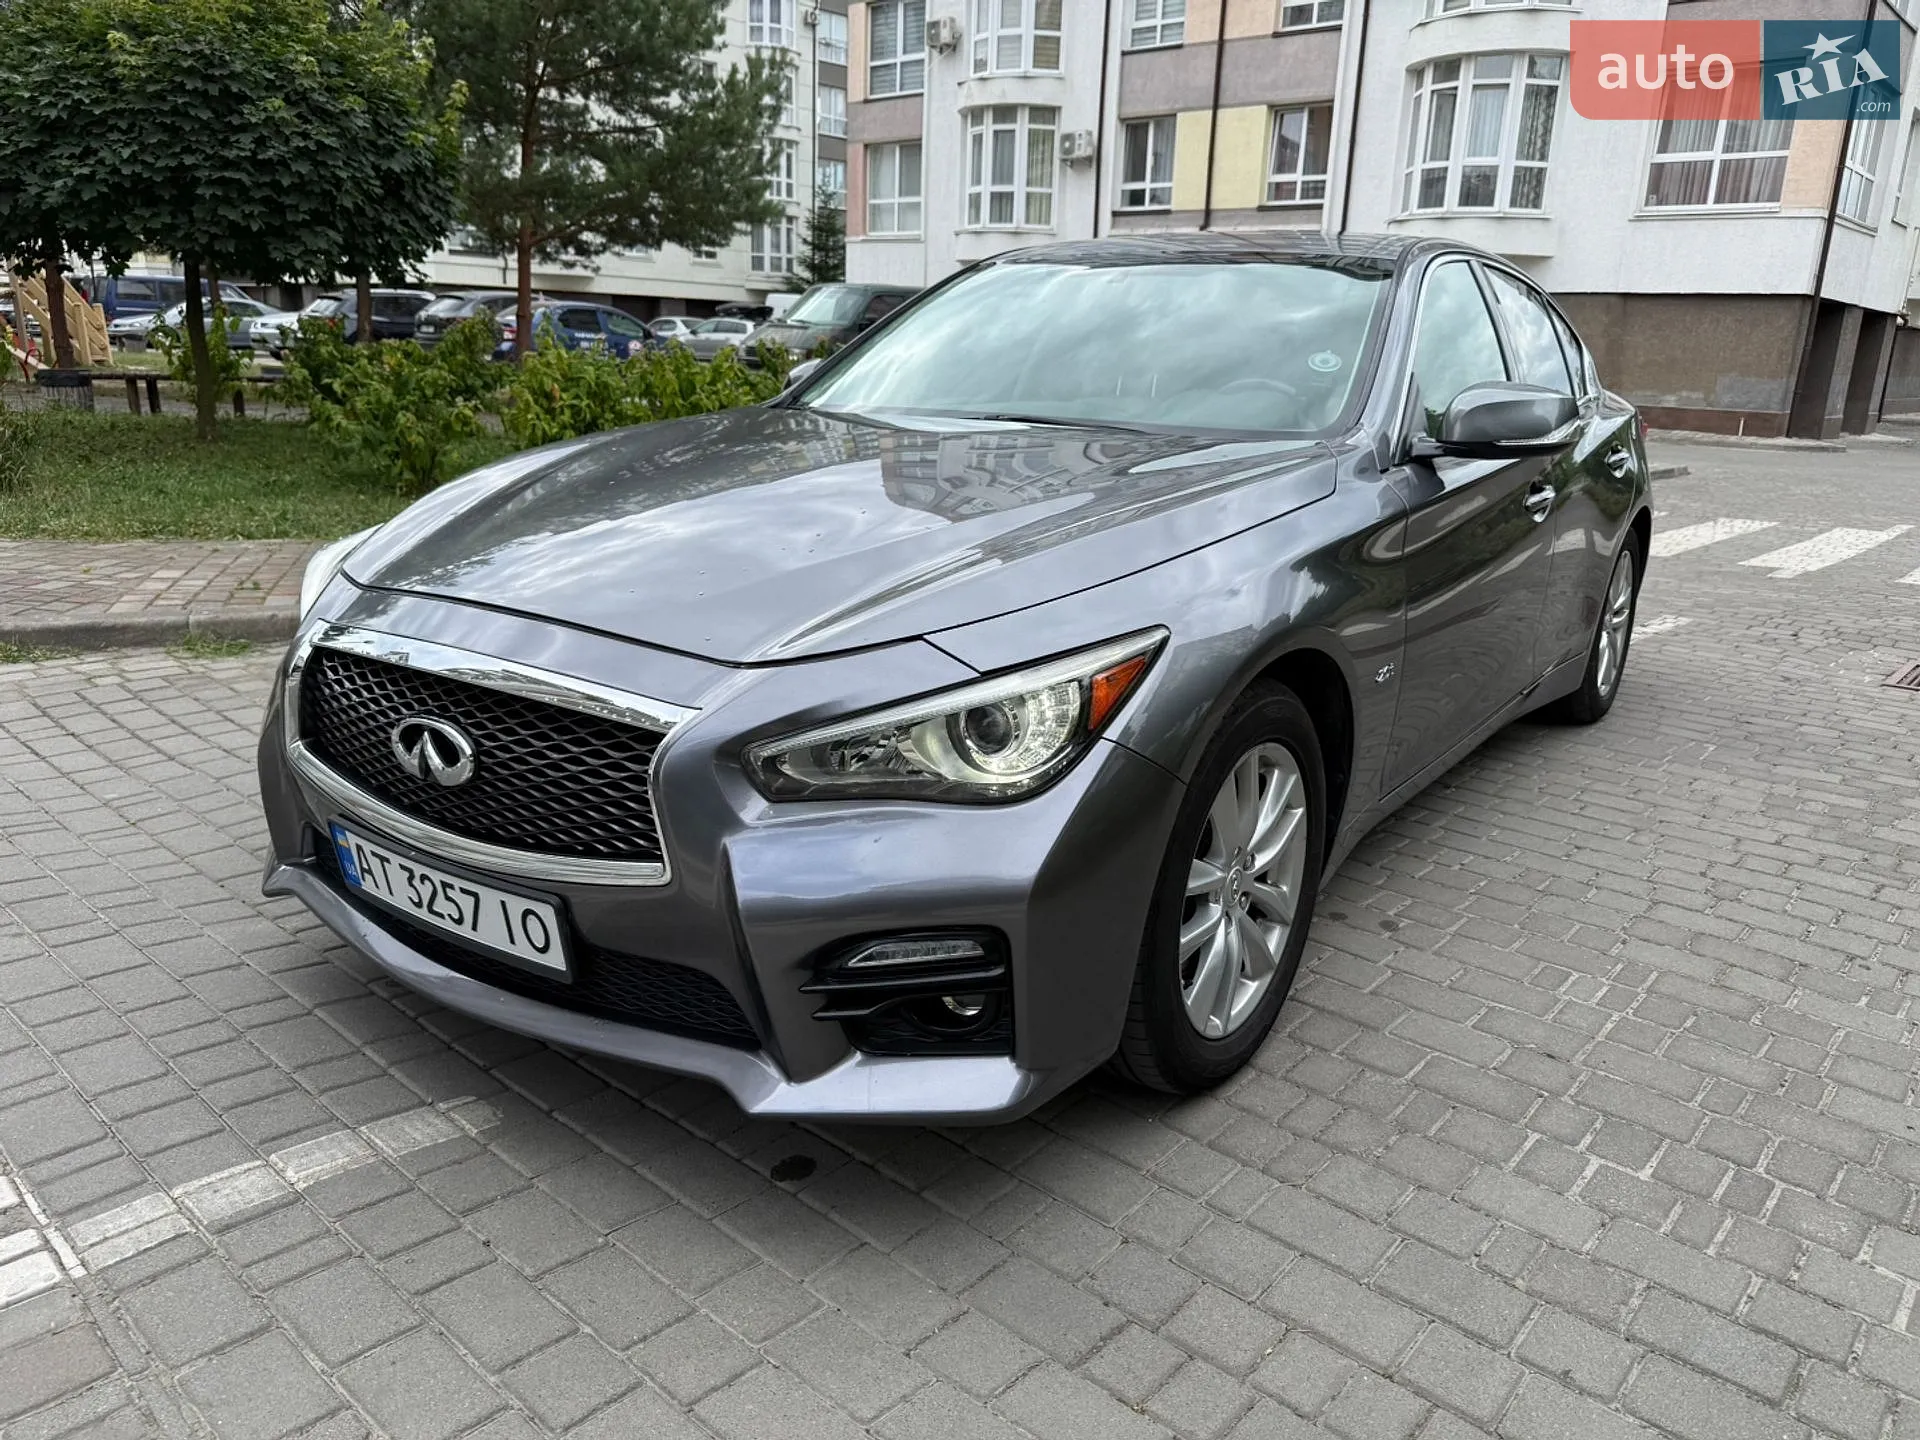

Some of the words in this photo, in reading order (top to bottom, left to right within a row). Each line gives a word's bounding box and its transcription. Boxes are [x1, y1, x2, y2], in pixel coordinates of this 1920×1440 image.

[355, 842, 394, 897] AT
[399, 862, 481, 932] 3257
[500, 899, 551, 954] IO
